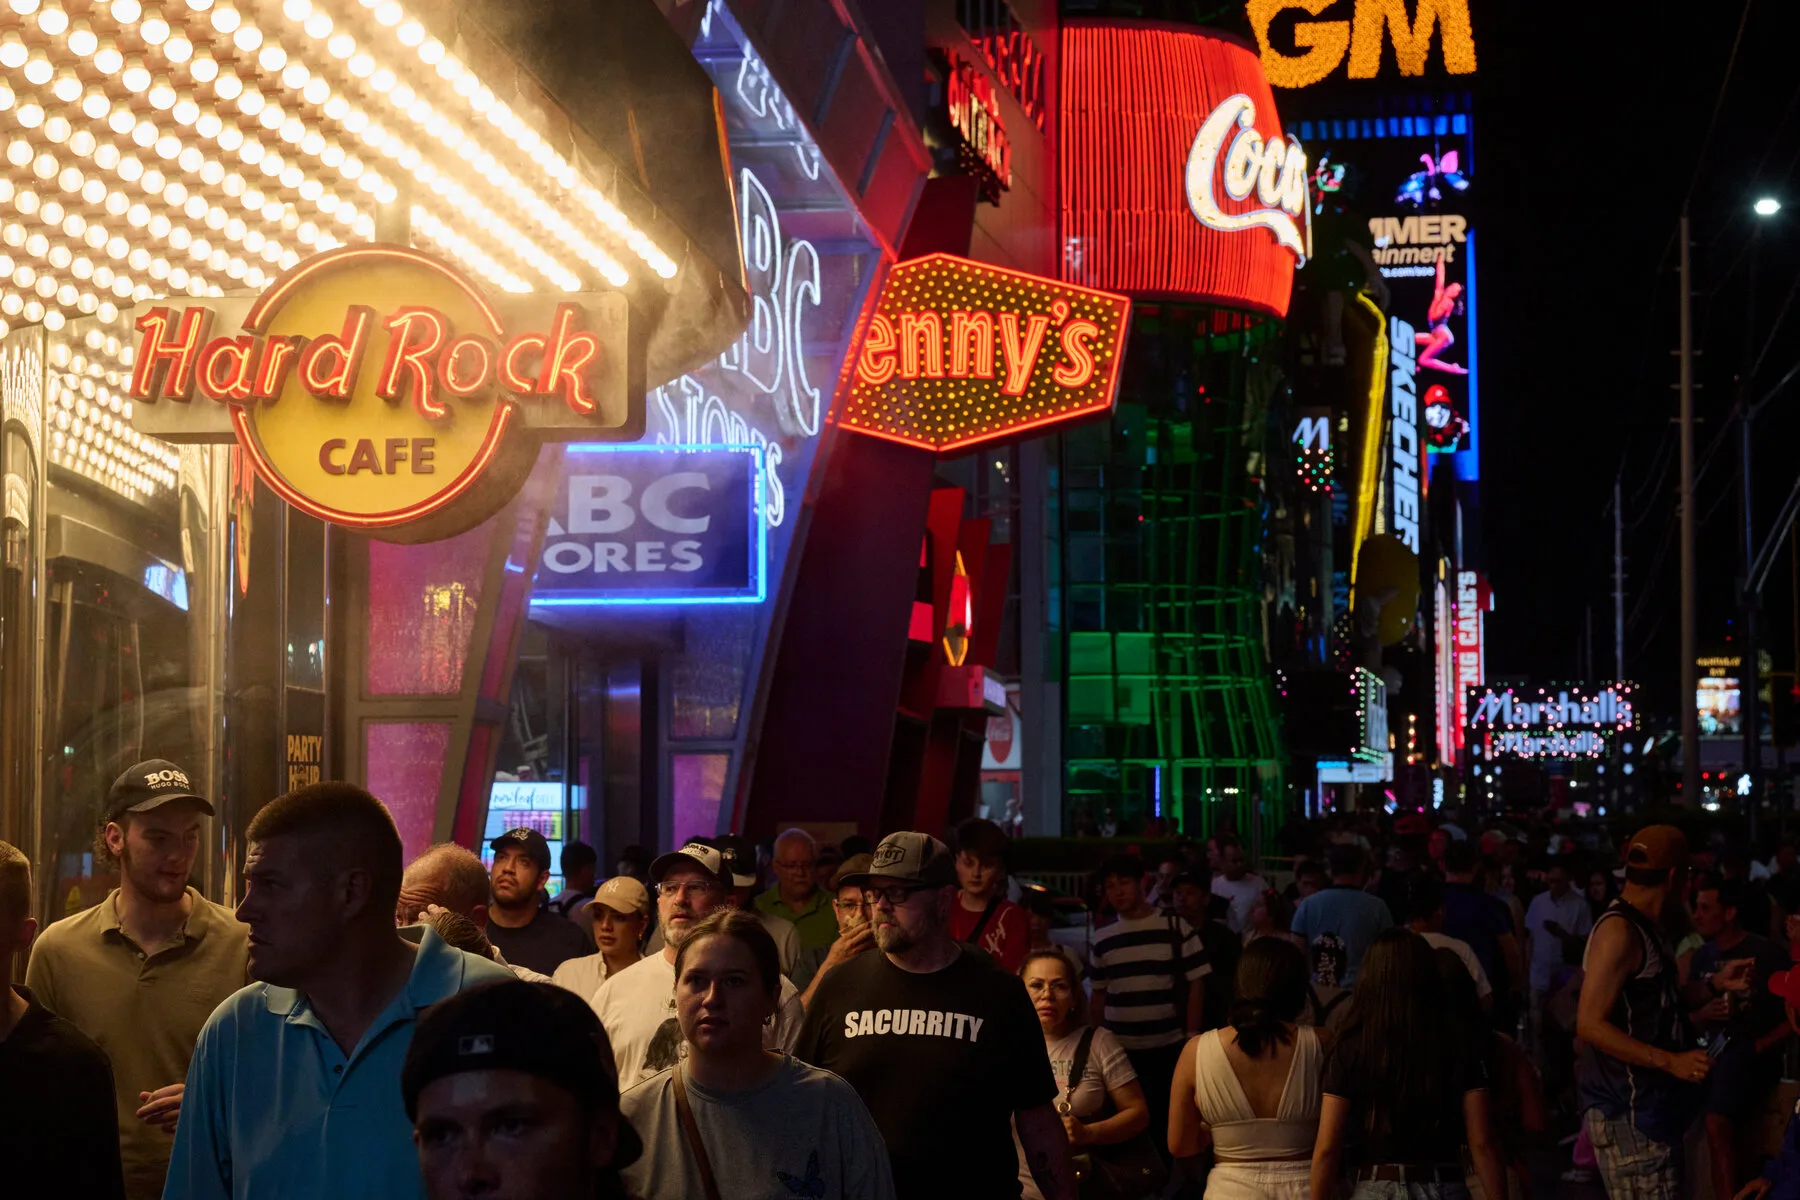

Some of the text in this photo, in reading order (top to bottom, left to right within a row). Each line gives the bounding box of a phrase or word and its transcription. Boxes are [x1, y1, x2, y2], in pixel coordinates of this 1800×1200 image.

[1245, 0, 1477, 88] GM
[1185, 93, 1308, 270] Coca
[720, 167, 821, 436] BC
[129, 302, 600, 419] Hard Rock
[857, 299, 1099, 396] enny's
[1390, 315, 1420, 555] SKECHER
[318, 437, 434, 475] CAFE
[543, 540, 703, 574] ORES
[1457, 570, 1478, 646] CANE'S
[1471, 690, 1633, 725] Marshalls
[287, 735, 322, 762] PARTY
[1493, 731, 1605, 754] Marshalls
[144, 769, 189, 786] BOSS
[150, 781, 190, 790] HUGO BOSS
[844, 1008, 984, 1043] SACURRITY
